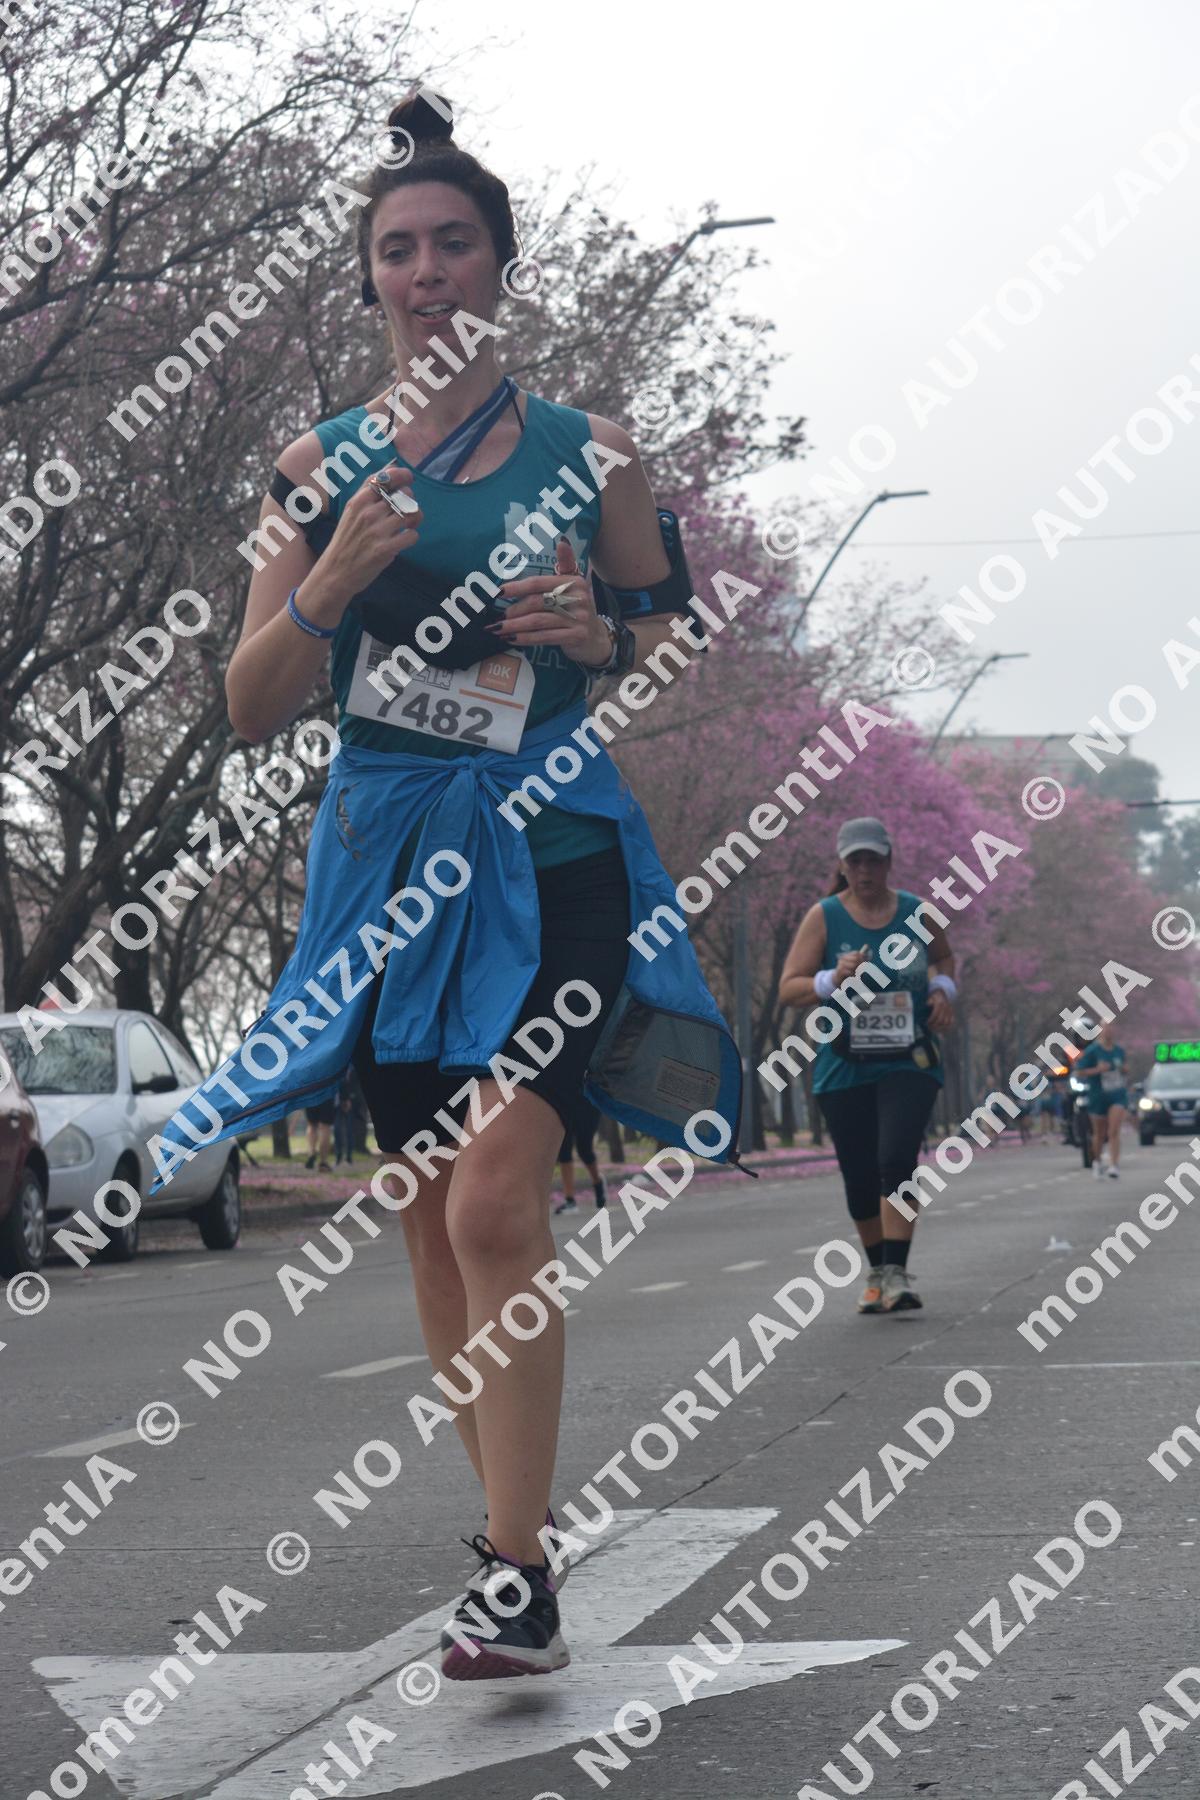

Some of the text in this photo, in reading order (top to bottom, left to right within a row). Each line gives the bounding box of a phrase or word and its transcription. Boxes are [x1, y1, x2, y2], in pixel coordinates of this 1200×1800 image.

[512, 553, 558, 565] UERTO
[488, 663, 512, 679] 10K
[377, 684, 493, 745] 7482
[857, 1014, 906, 1030] 8230
